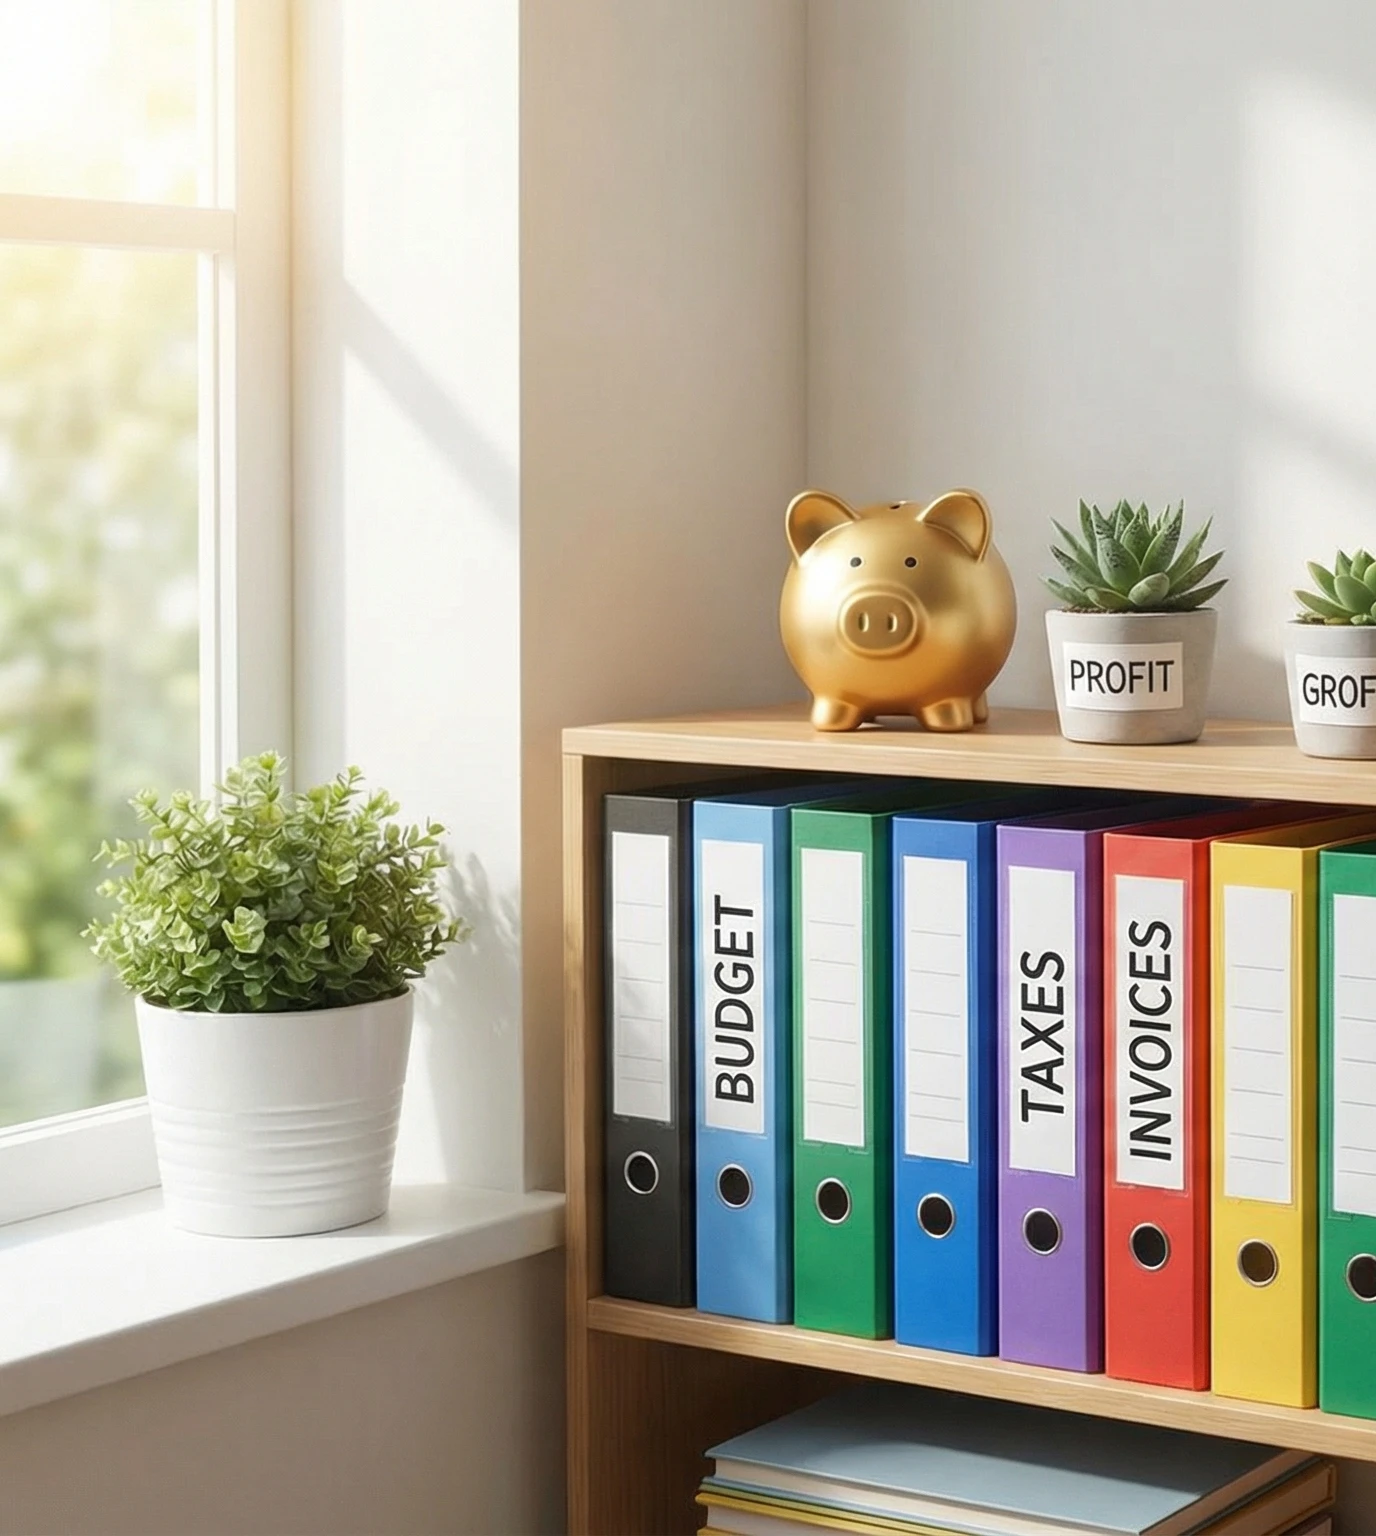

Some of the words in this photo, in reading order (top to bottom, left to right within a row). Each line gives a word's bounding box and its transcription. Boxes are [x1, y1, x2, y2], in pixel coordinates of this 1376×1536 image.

[1070, 659, 1175, 694] PROFIT
[713, 894, 755, 1104] BUDGET
[1020, 951, 1065, 1123] TAXES
[1128, 920, 1173, 1161] INVOICES
